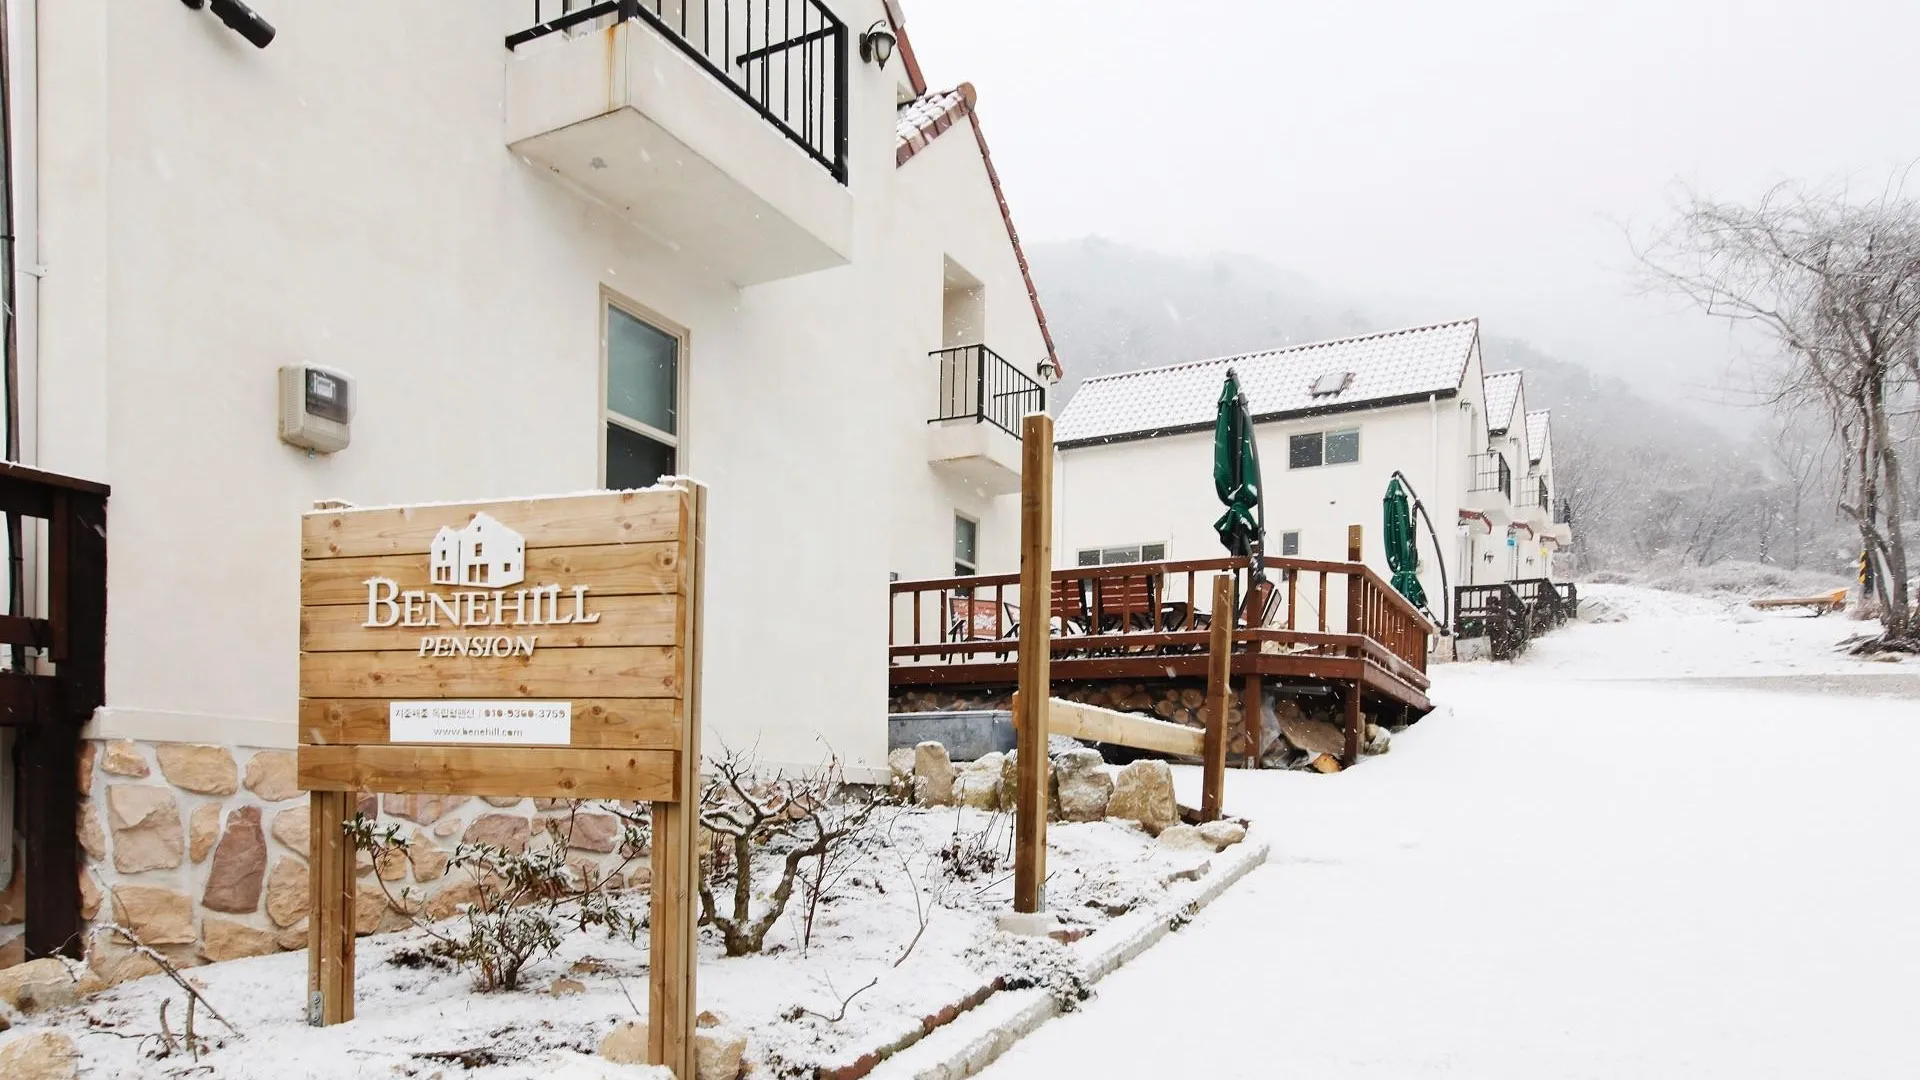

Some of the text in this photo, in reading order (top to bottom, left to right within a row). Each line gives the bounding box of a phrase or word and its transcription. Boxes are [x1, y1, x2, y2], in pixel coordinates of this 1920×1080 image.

[361, 576, 601, 628] BENEHILL
[418, 635, 538, 658] PENSION
[433, 727, 523, 737] www.benehill.com
